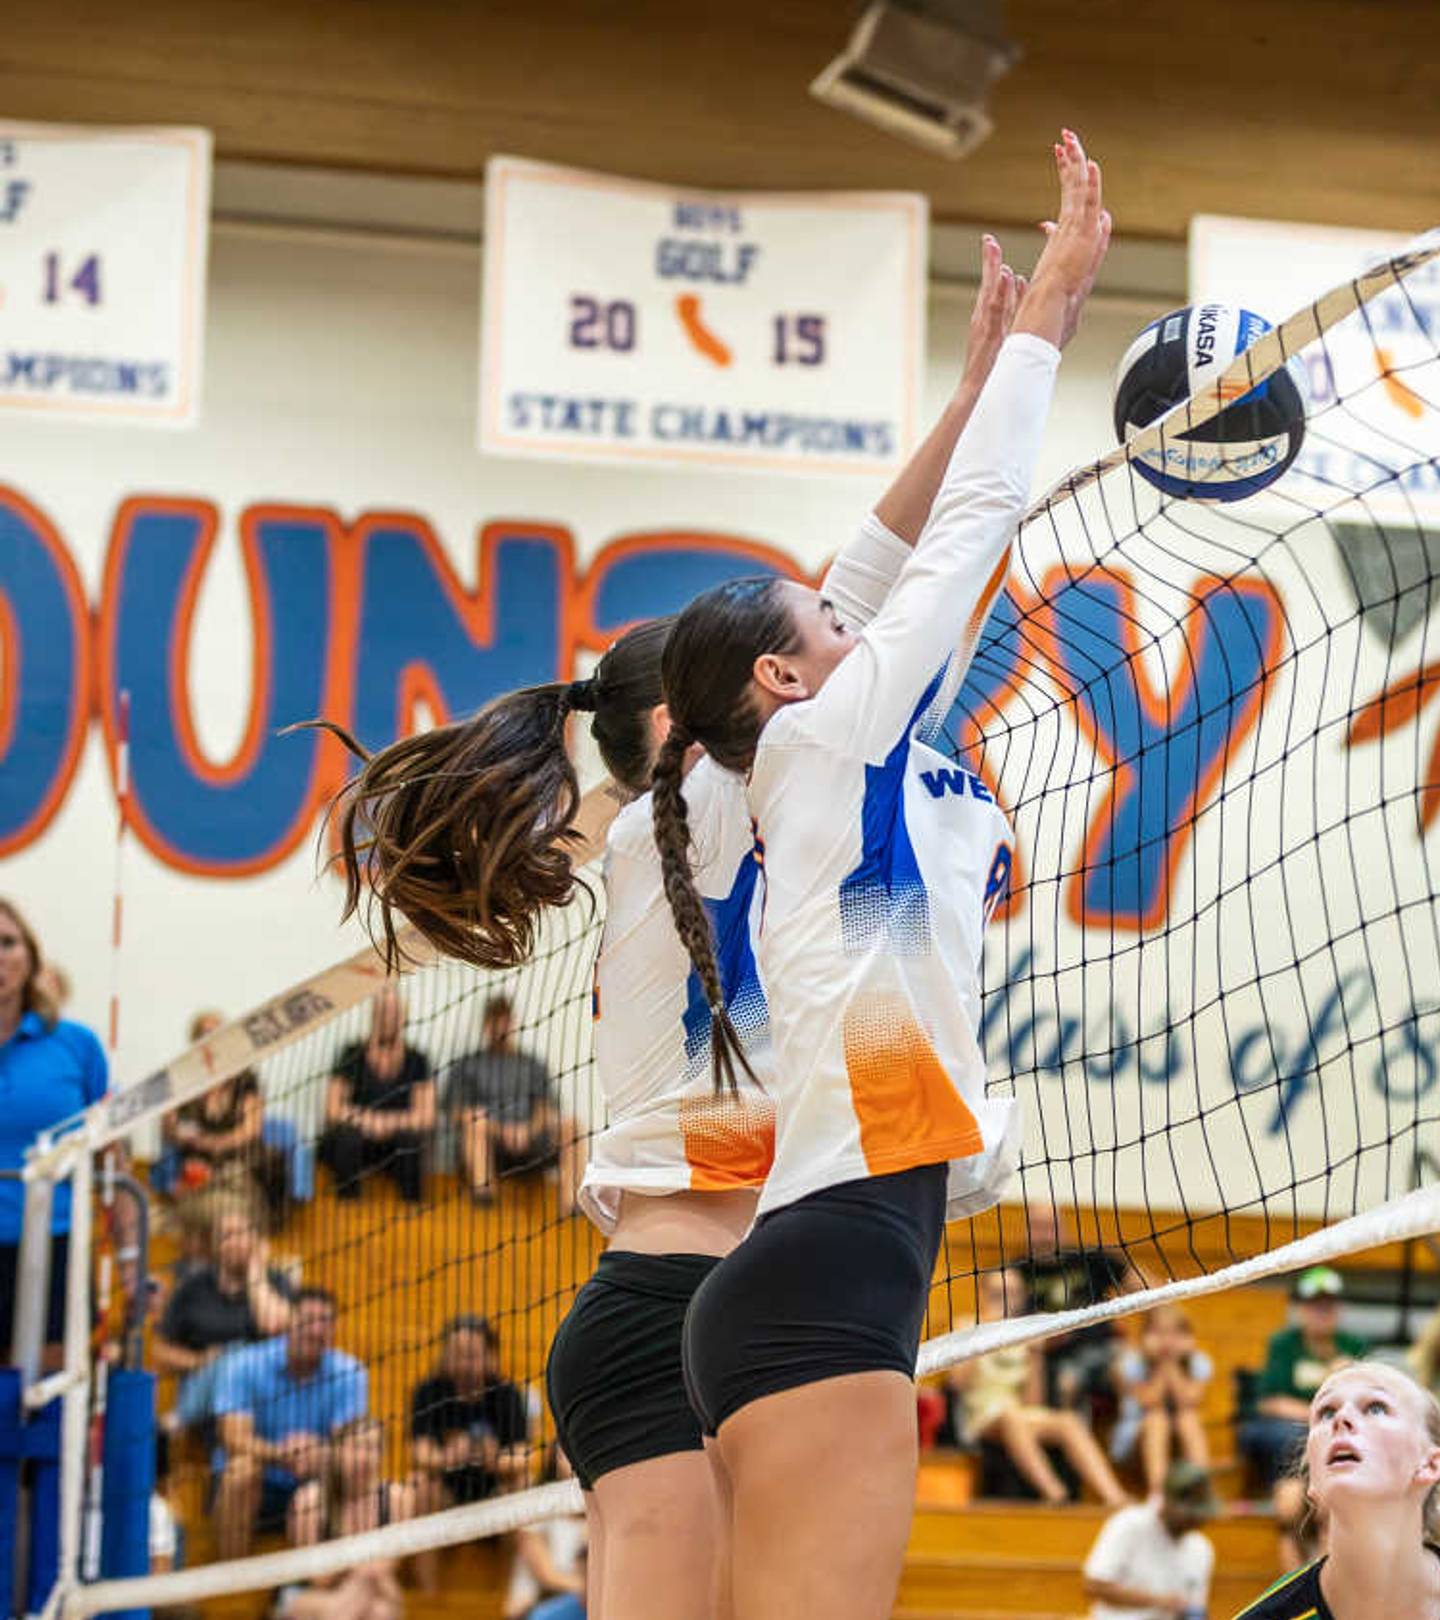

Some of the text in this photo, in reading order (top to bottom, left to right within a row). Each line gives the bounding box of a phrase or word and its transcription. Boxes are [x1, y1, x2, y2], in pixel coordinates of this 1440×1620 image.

[44, 249, 101, 307] 14
[656, 238, 758, 285] GOLF
[570, 296, 826, 367] 20 15
[509, 393, 896, 455] STATE CHAMPIONS
[977, 944, 1184, 1084] lass
[1228, 967, 1374, 1137] of
